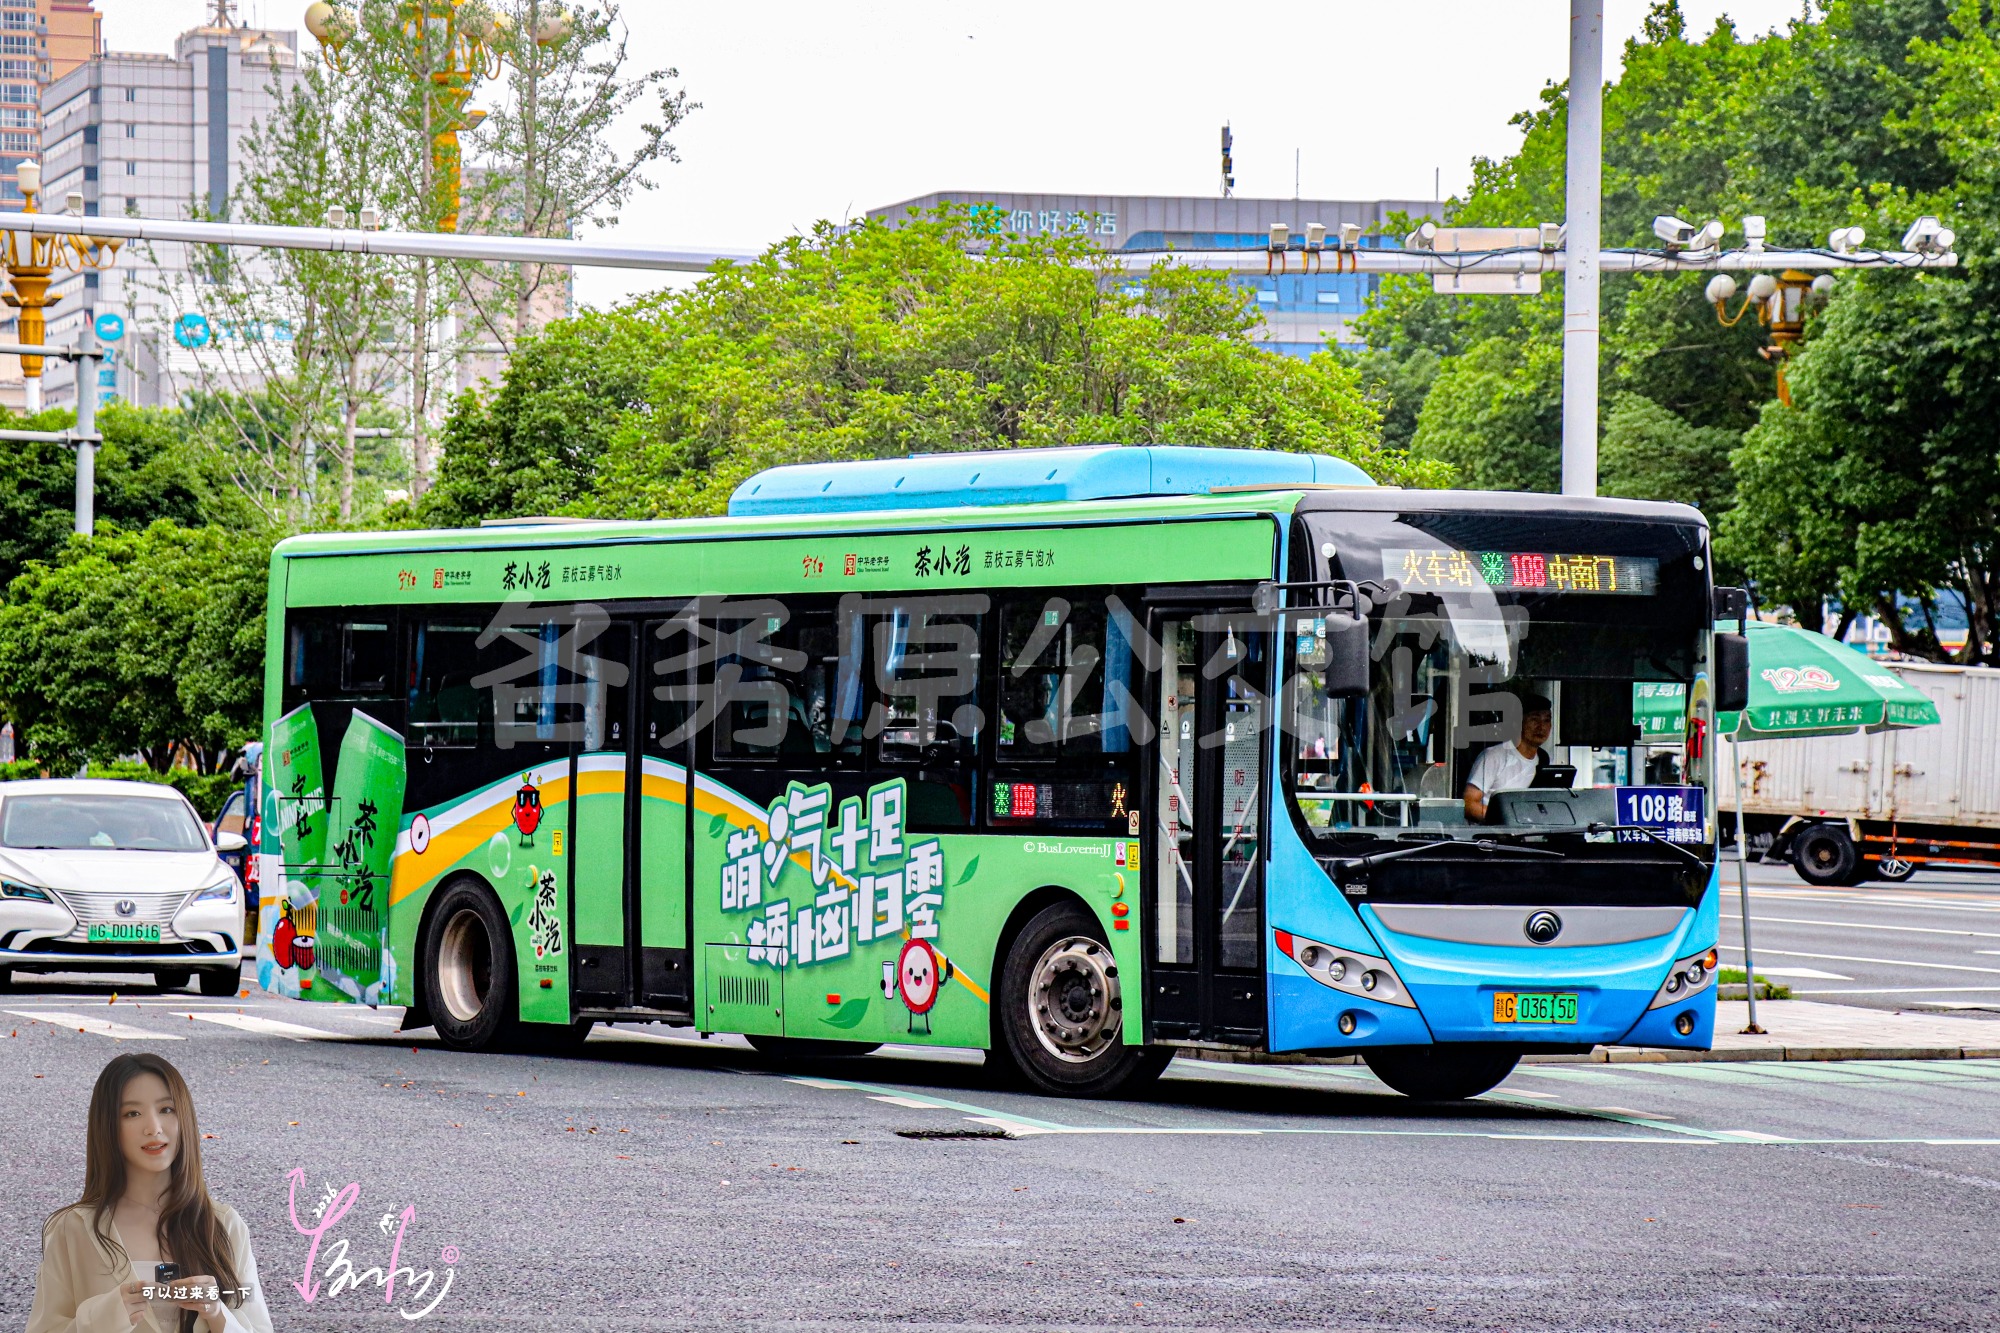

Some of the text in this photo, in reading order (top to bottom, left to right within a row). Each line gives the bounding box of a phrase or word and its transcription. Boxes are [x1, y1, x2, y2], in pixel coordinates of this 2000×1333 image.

[1010, 210, 1117, 235] 你好酒店
[562, 564, 622, 583] 荔枝云雾气泡水
[915, 544, 971, 577] 茶小汽
[983, 549, 1055, 569] 荔枝云雾气泡水
[1403, 550, 1471, 586] 火车站
[1511, 554, 1547, 587] 108
[502, 561, 550, 591] 茶小汽
[1769, 706, 1864, 727] 共创美好未来
[1168, 768, 1180, 866] 注意开门
[1233, 769, 1246, 867] 防止夹伤
[1628, 794, 1683, 822] 108路
[721, 787, 904, 909] 萌汽十足
[1622, 827, 1703, 842] 火车站 浔南停车场
[529, 873, 562, 953] 茶小汽
[747, 841, 943, 966] 烦恼归零
